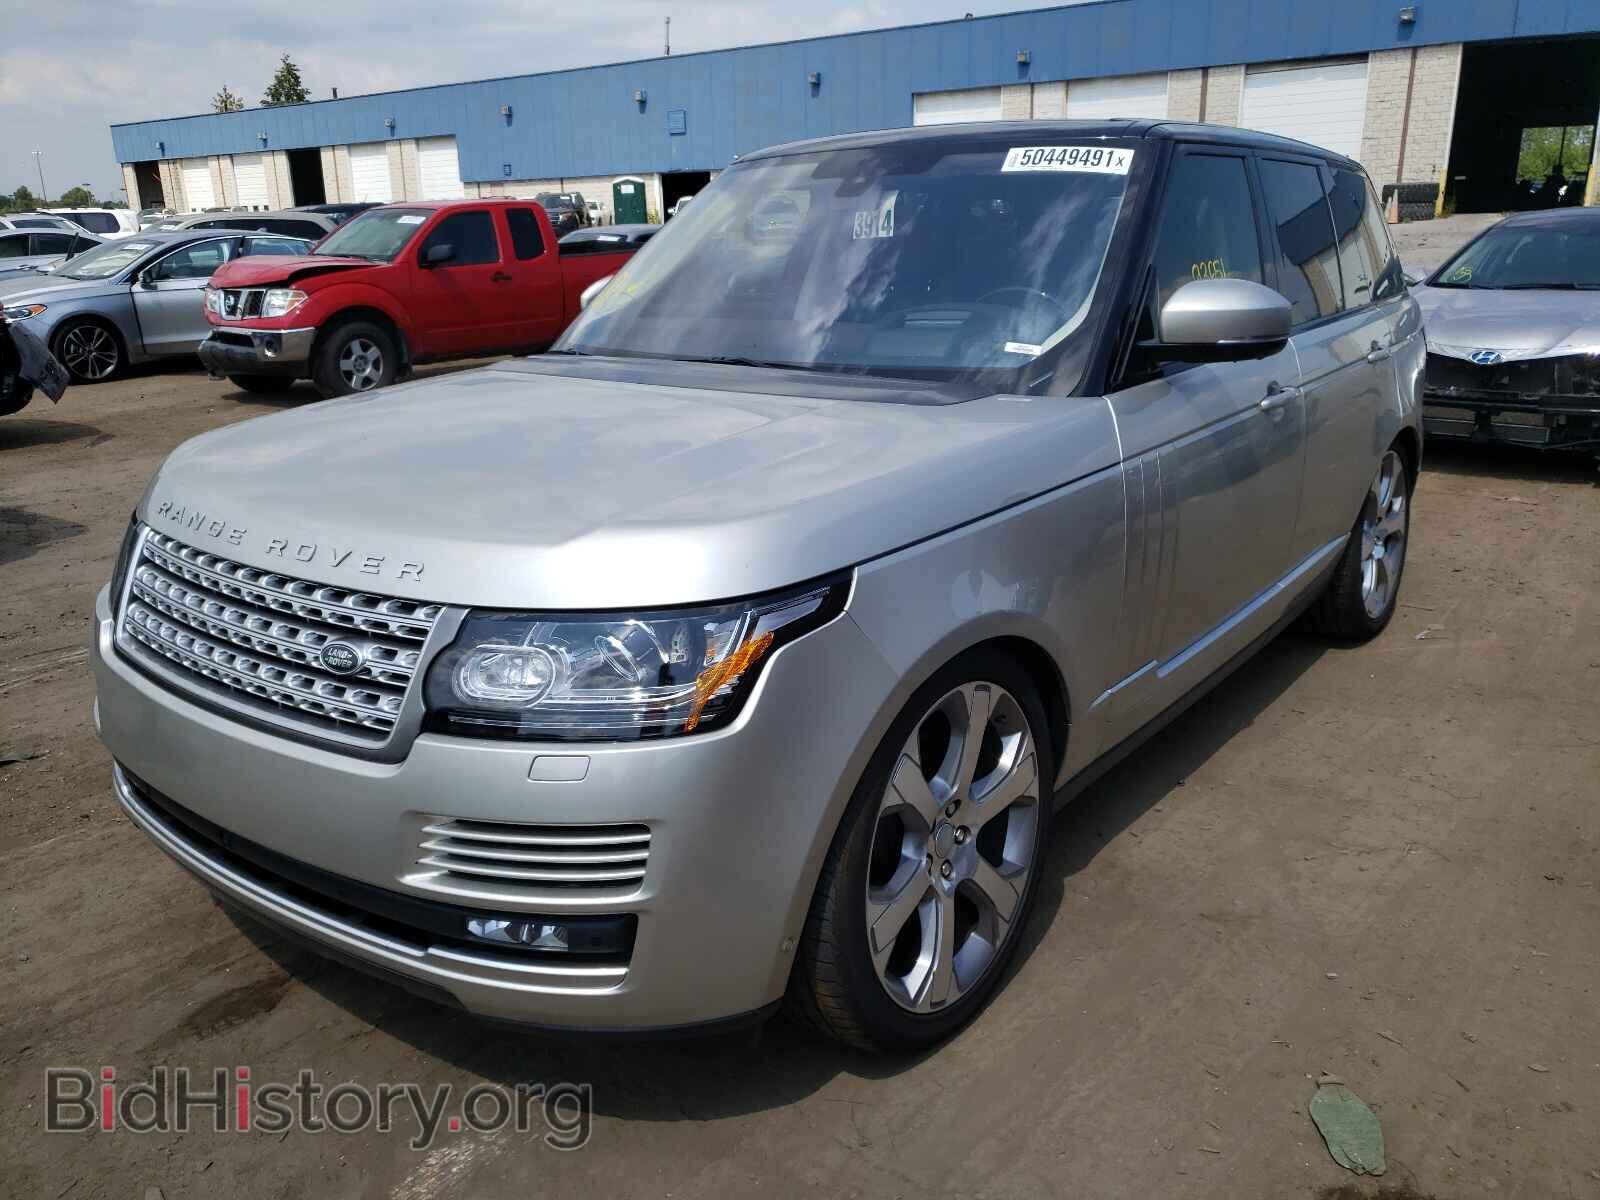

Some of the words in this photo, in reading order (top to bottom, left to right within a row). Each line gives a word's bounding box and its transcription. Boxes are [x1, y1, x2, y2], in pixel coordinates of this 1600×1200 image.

[1020, 148, 1114, 168] 50449491
[157, 500, 248, 546] RANGE
[265, 535, 426, 583] ROVER
